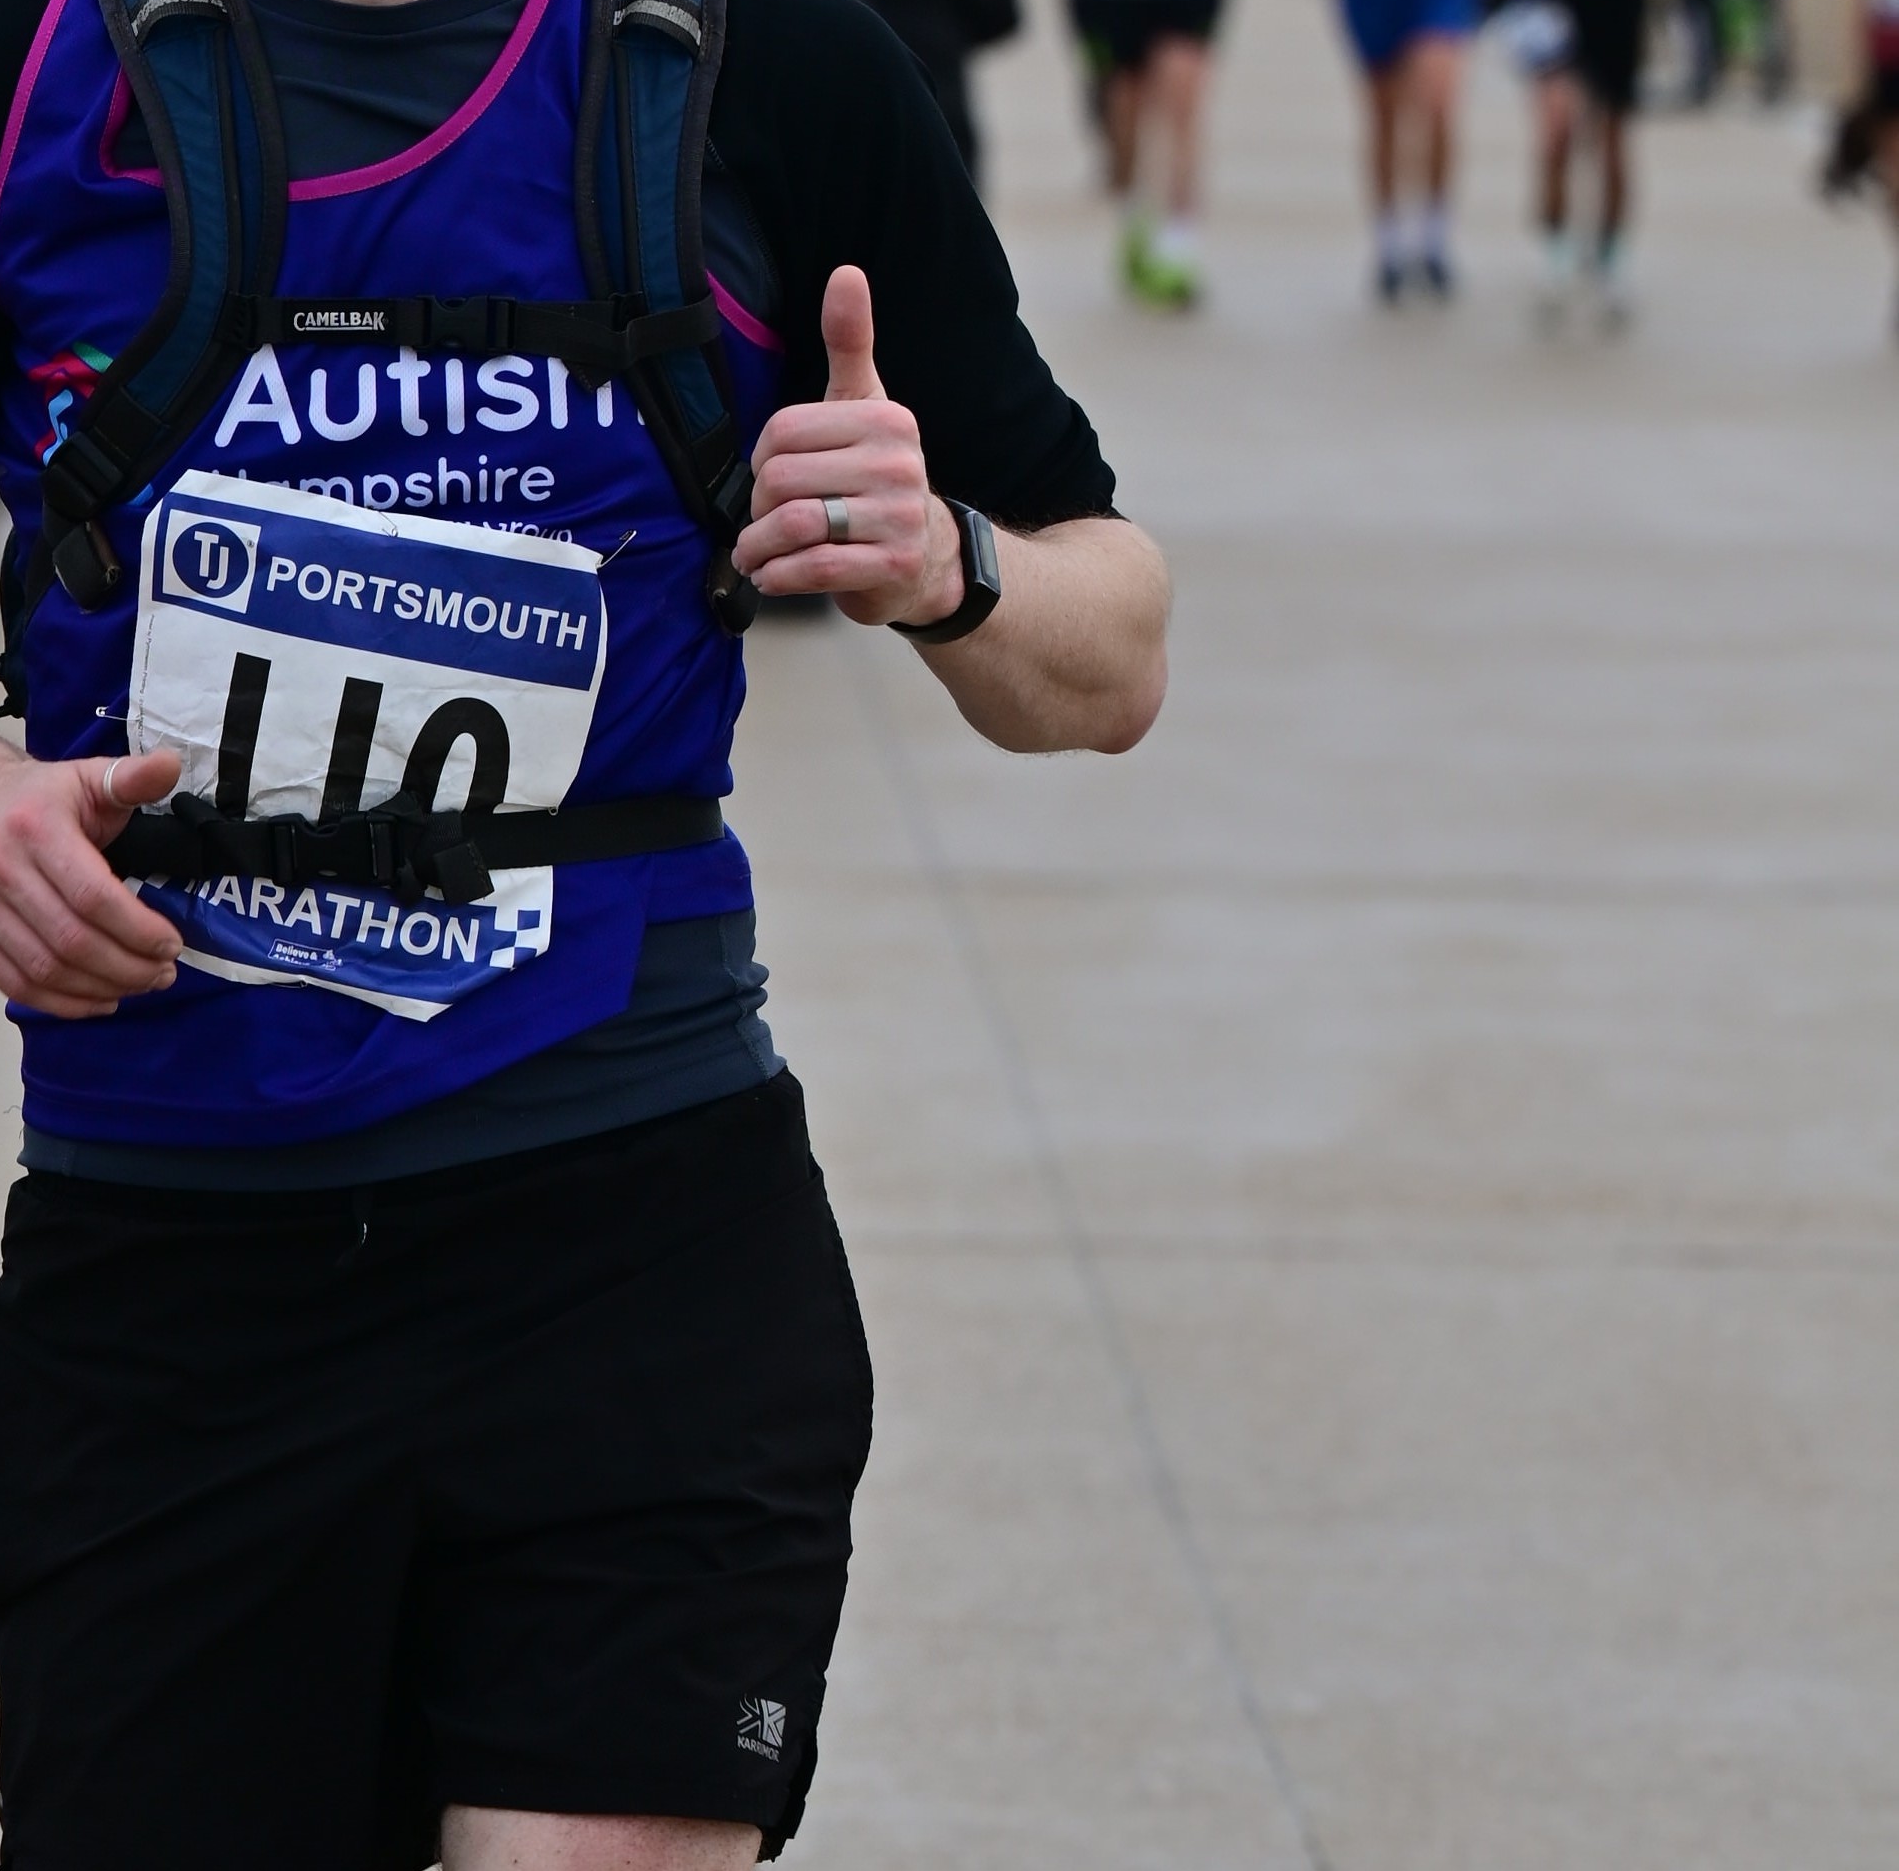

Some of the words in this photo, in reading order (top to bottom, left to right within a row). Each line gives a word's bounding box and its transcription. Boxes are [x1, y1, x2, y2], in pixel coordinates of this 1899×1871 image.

[293, 311, 385, 331] CAMELBAK
[211, 454, 555, 510] mpshire
[266, 556, 588, 651] PORTSMOUTH
